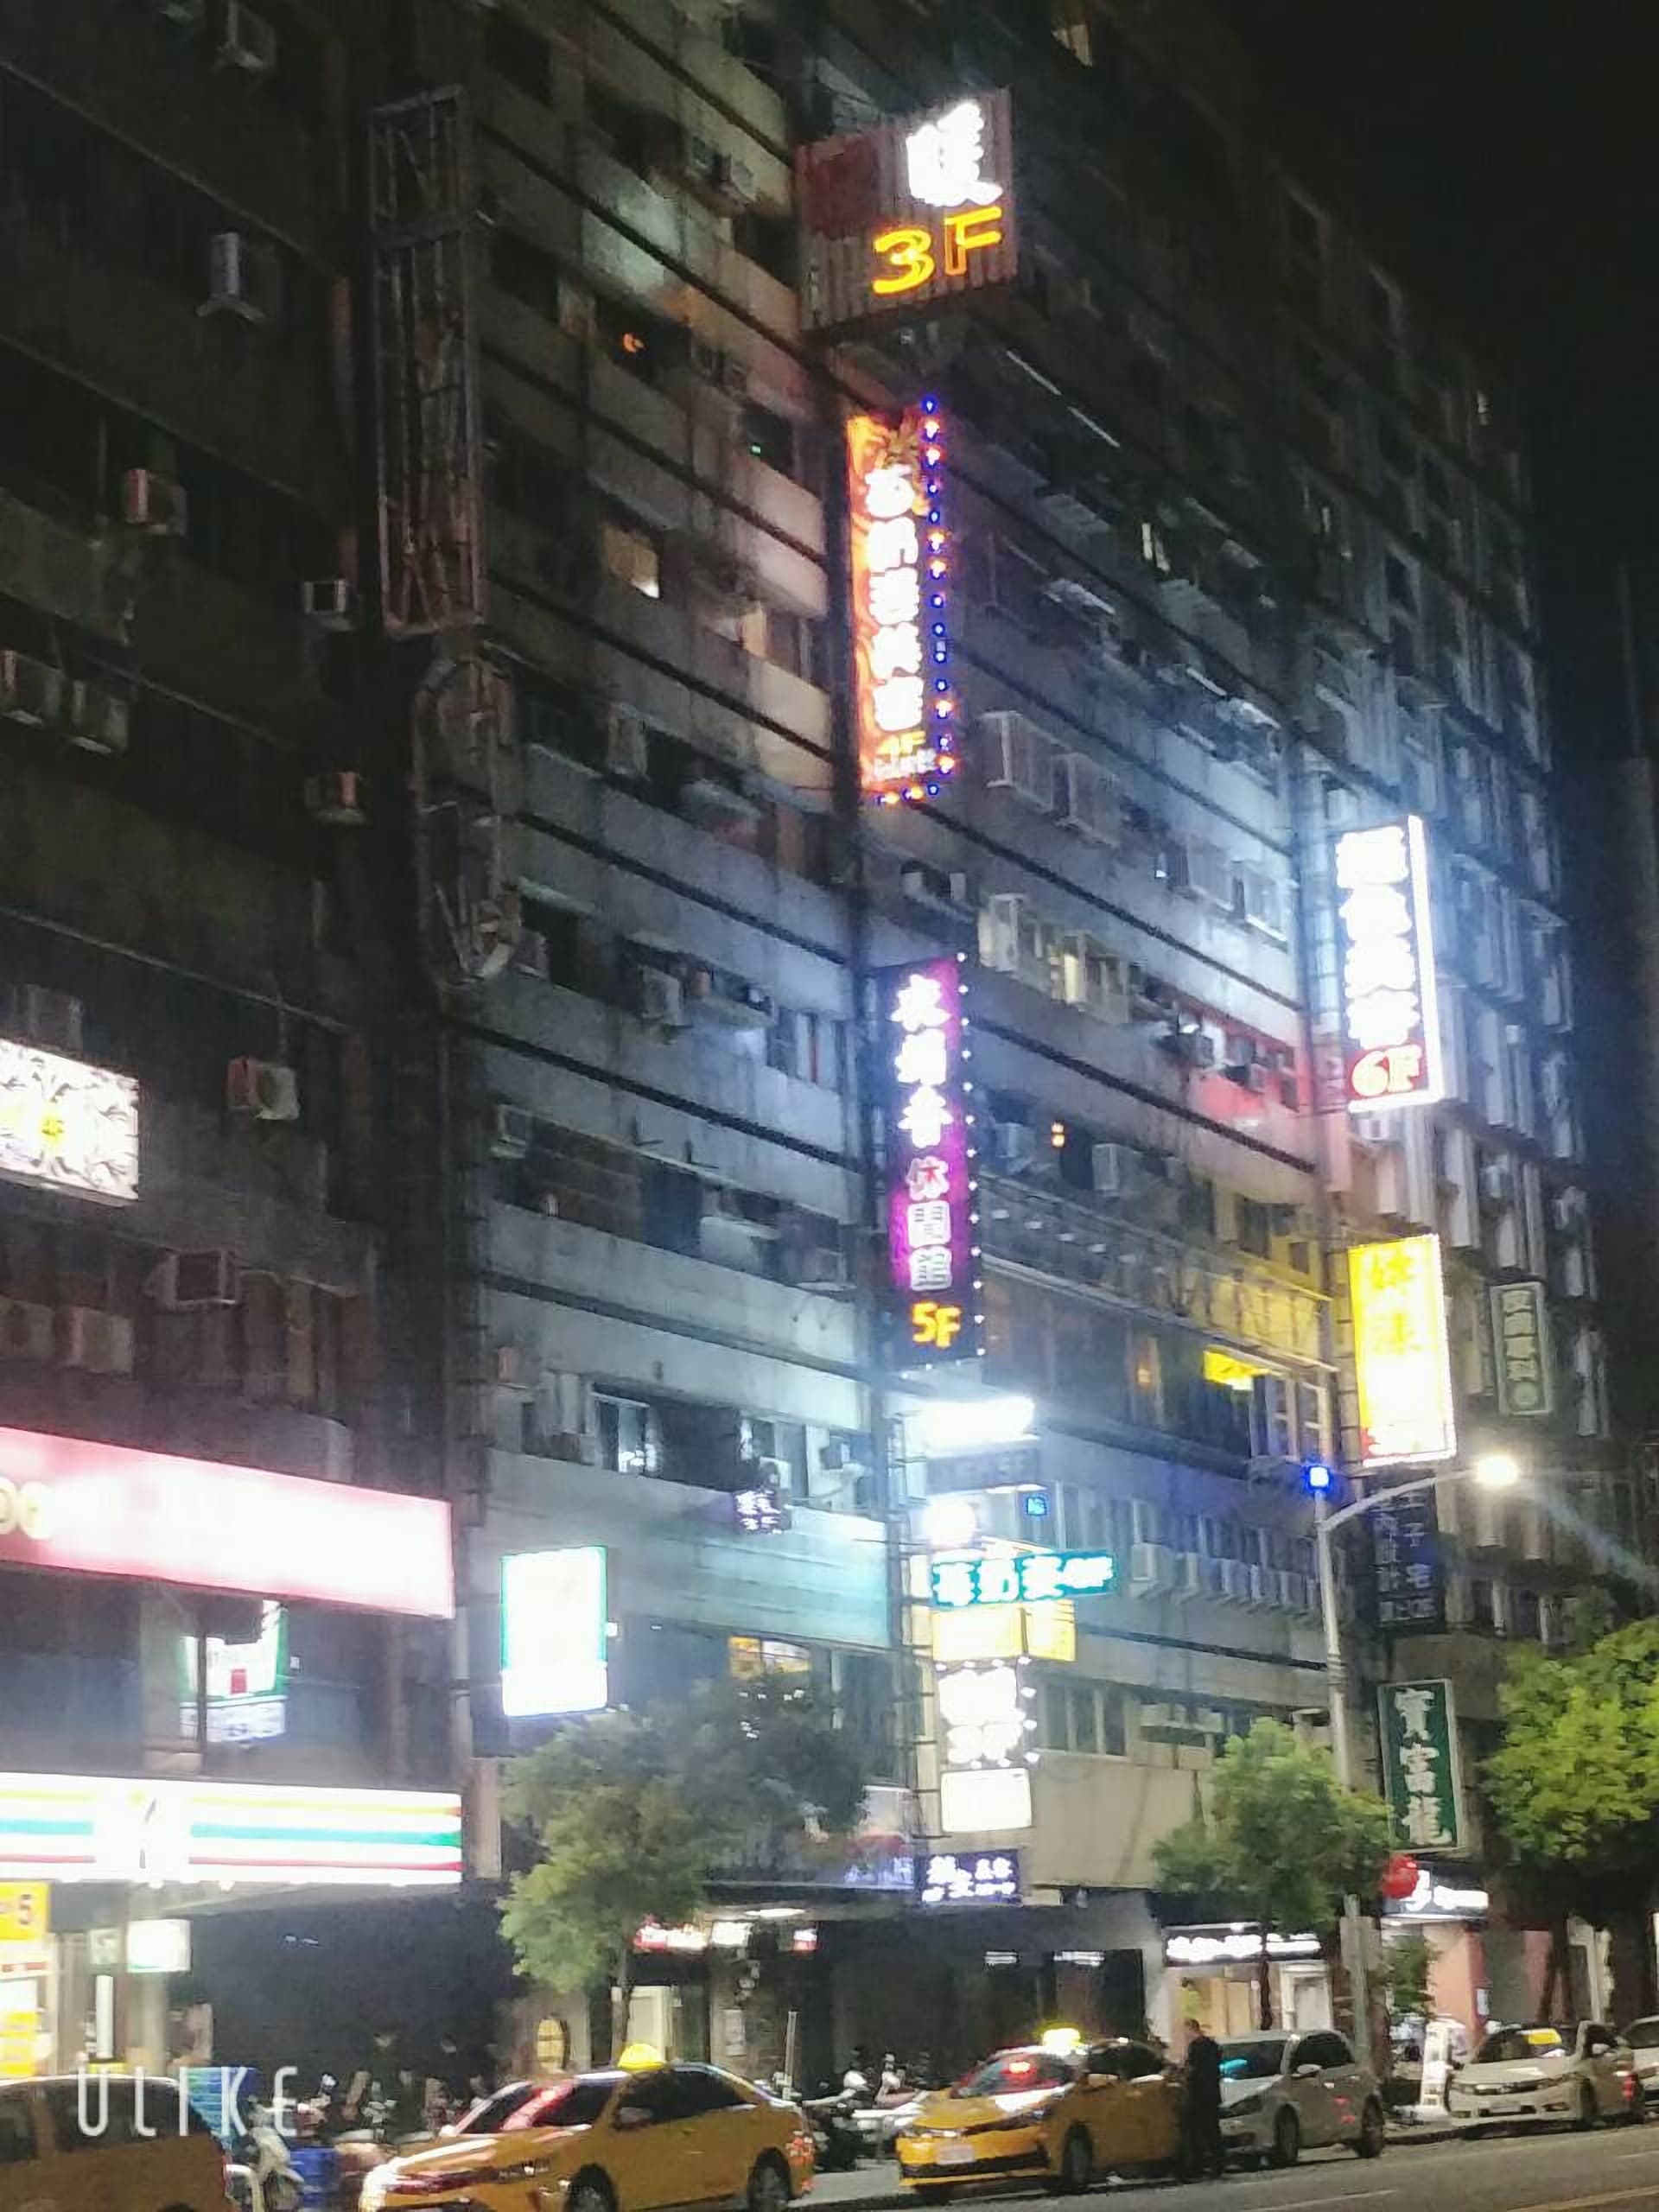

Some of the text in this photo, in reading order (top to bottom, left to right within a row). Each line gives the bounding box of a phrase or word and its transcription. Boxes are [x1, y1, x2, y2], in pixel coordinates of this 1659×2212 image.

[873, 207, 1002, 294] 3F
[1351, 1044, 1422, 1096] 6F
[912, 1300, 961, 1348] 5F
